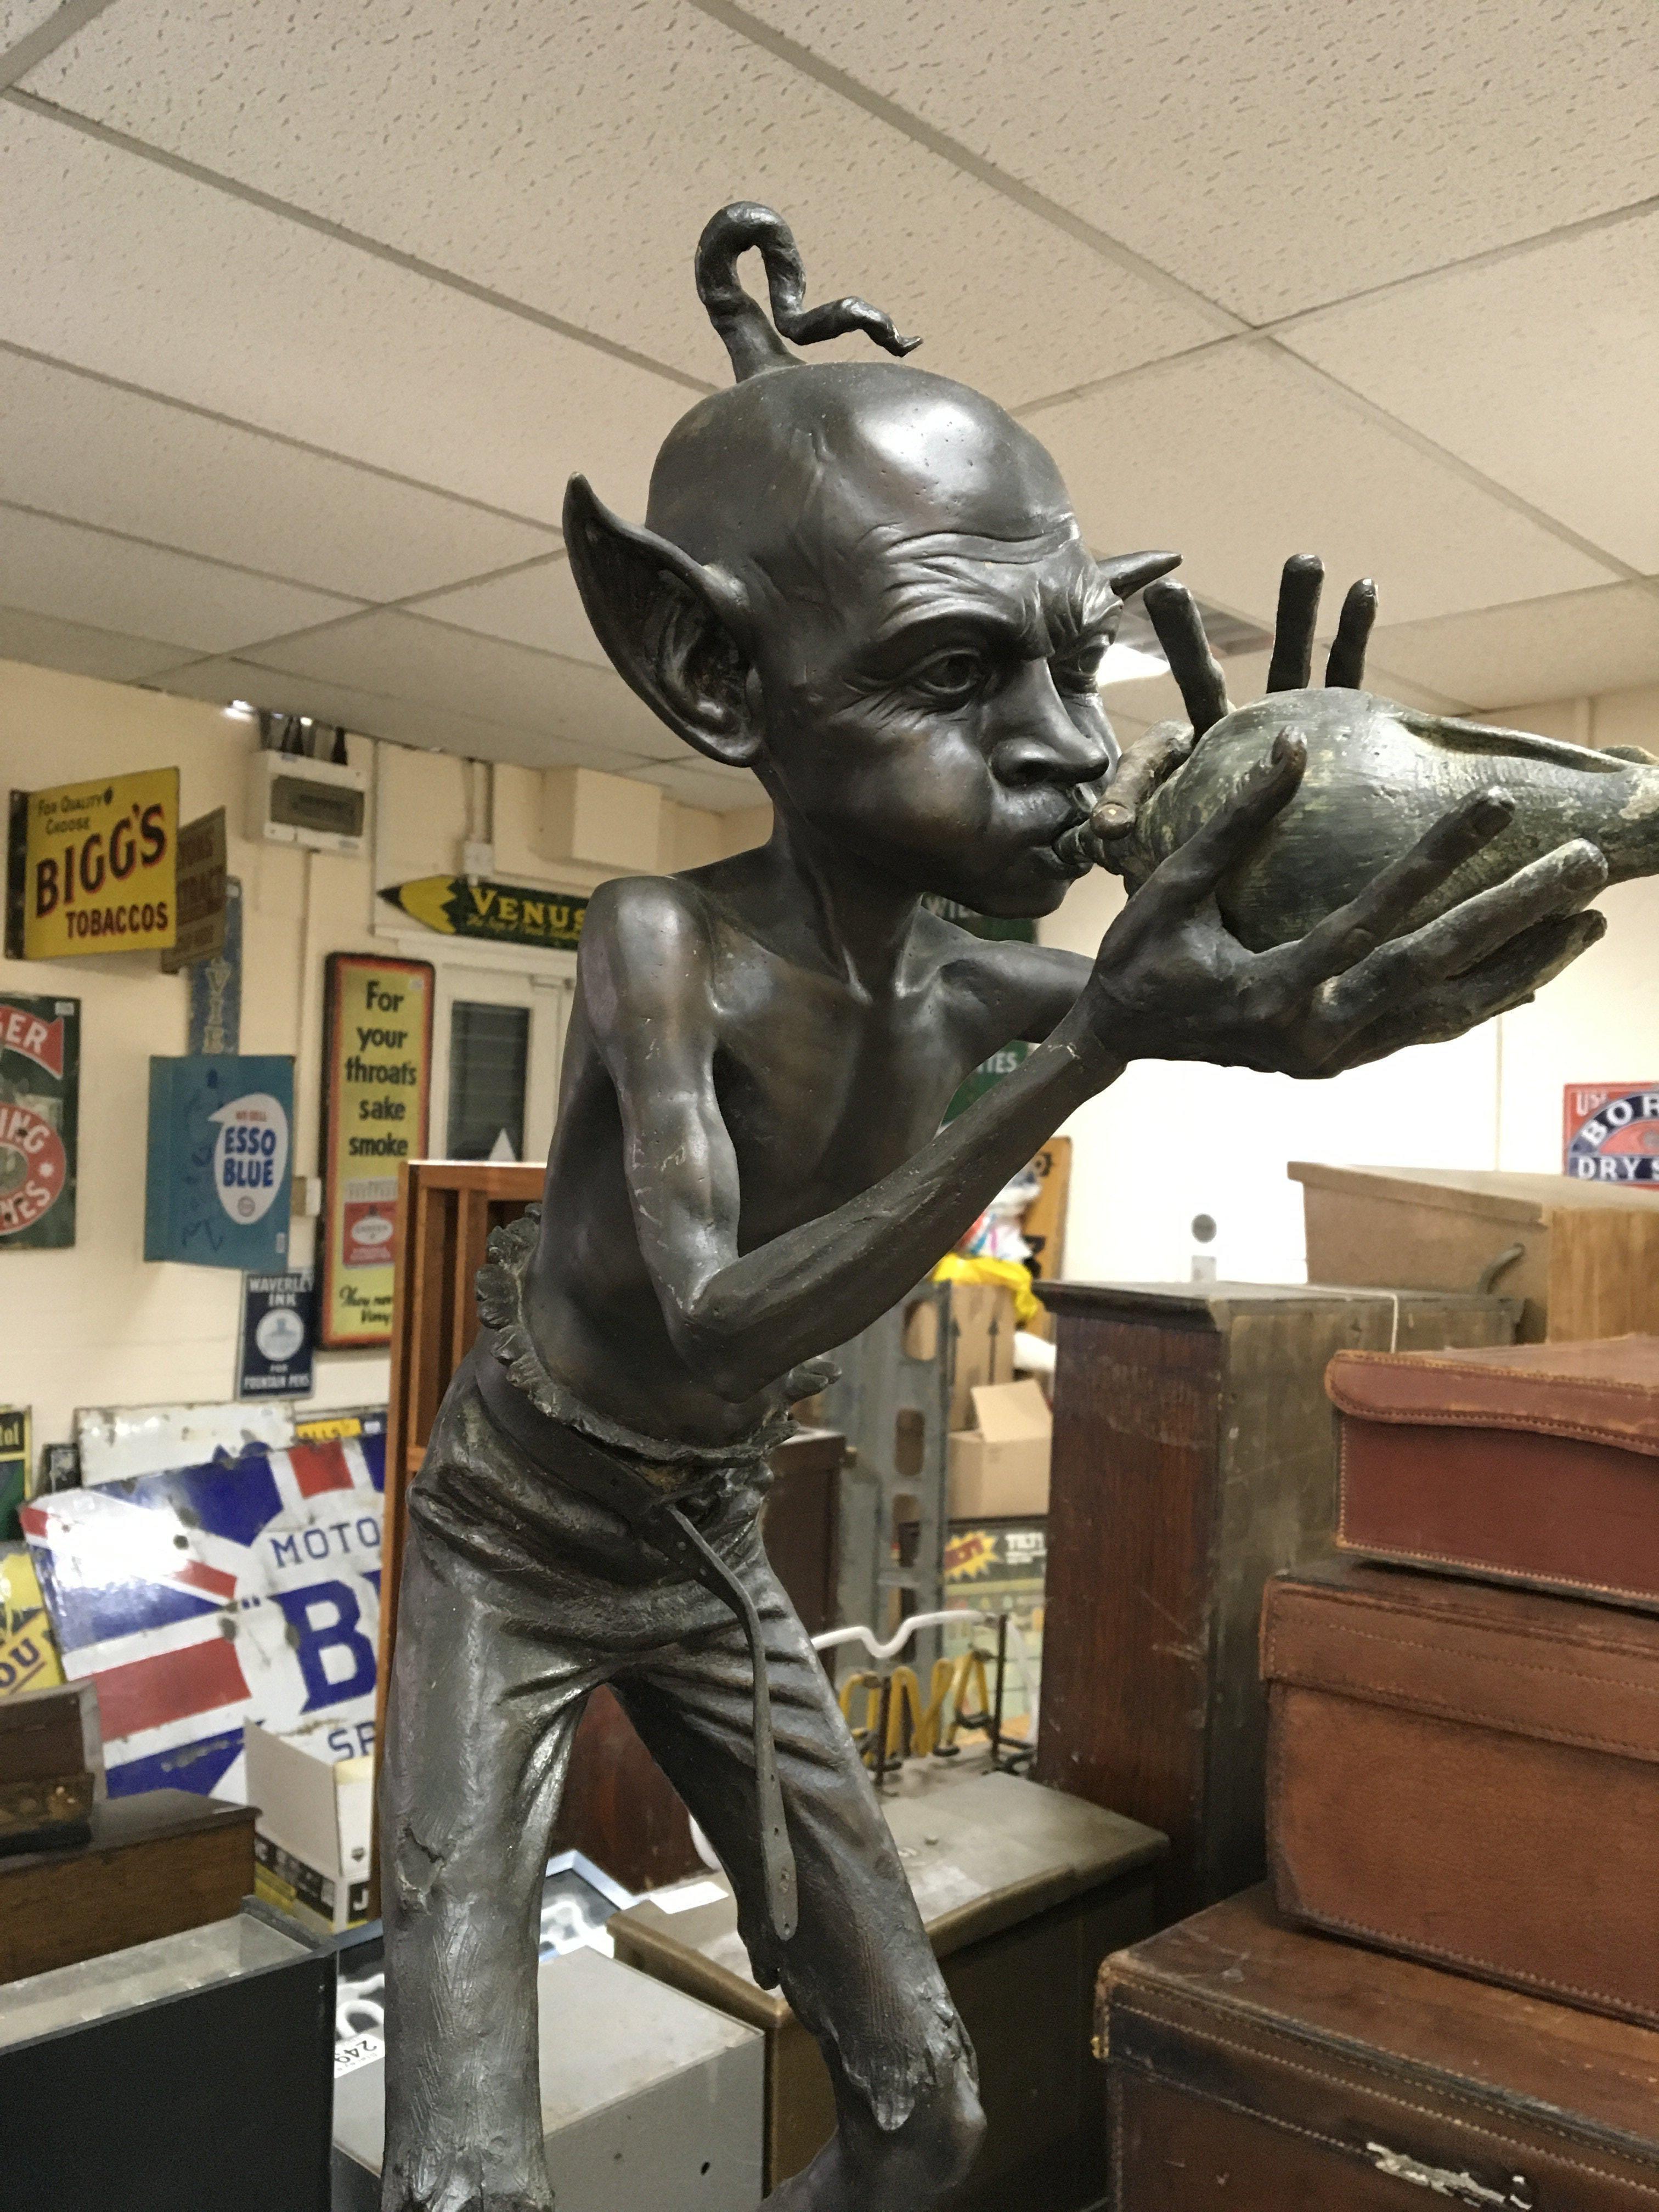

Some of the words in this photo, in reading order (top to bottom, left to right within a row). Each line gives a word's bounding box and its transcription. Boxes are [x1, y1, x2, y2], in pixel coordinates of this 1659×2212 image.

[35, 803, 166, 919] BIGG'S
[65, 901, 168, 939] TOBACCOS
[470, 887, 588, 932] VENUS
[365, 979, 405, 1012] For
[0, 1013, 48, 1054] ER
[356, 1026, 408, 1051] your
[359, 1096, 406, 1121] sake
[224, 1126, 276, 1154] ESSO
[348, 1133, 409, 1157] smoke
[223, 1158, 274, 1188] BLUE
[1578, 1156, 1643, 1180] DRY
[270, 1516, 381, 1568] MOTO
